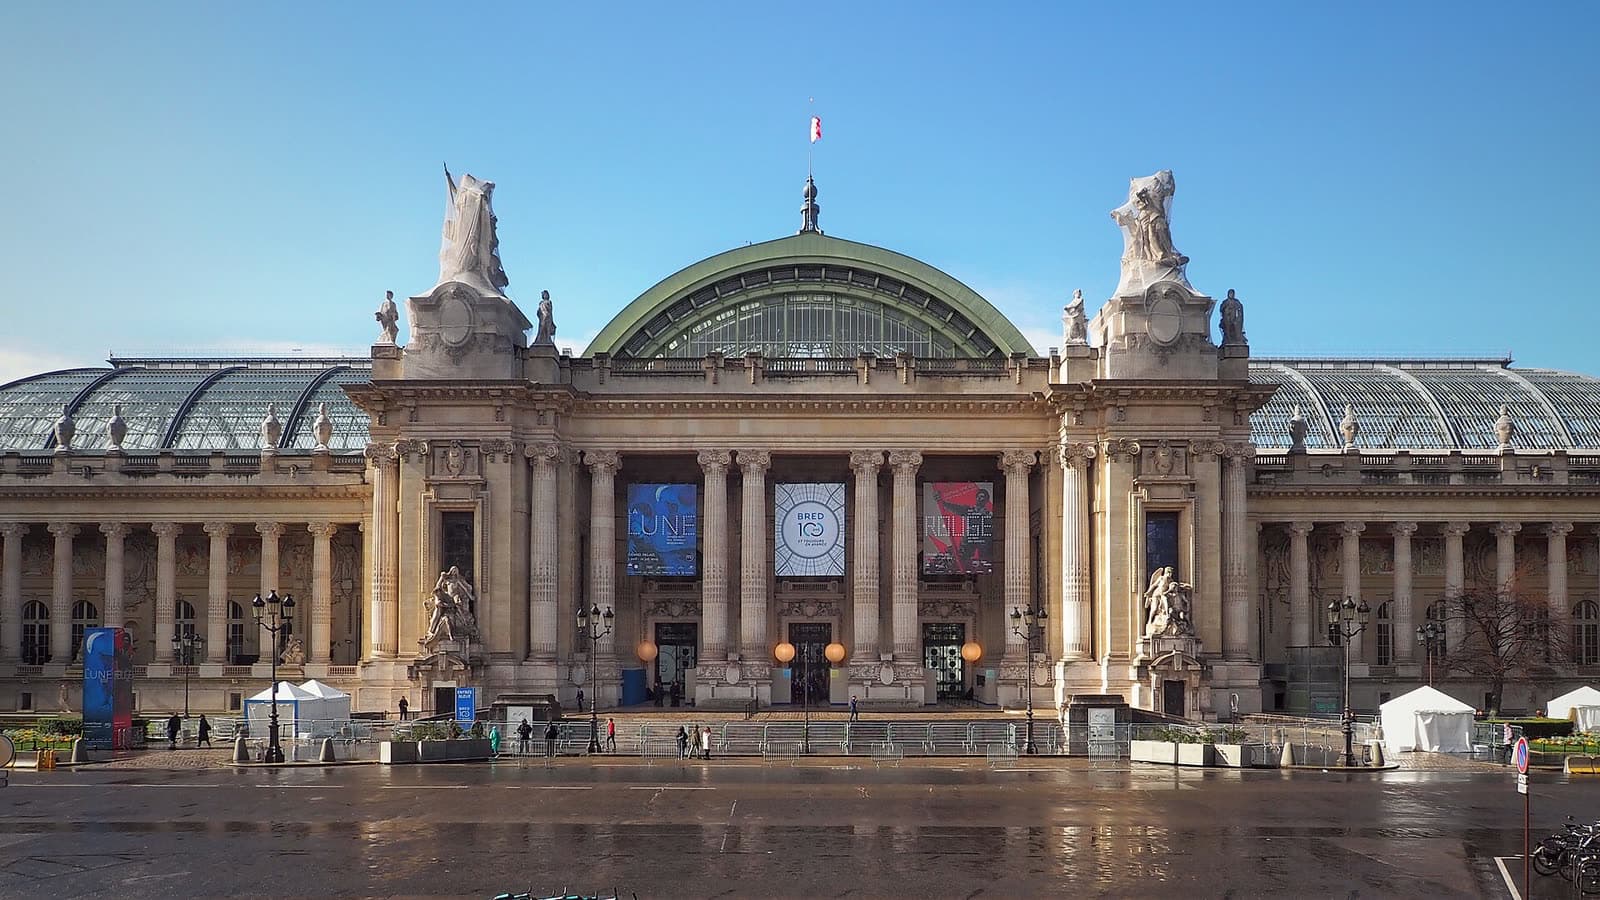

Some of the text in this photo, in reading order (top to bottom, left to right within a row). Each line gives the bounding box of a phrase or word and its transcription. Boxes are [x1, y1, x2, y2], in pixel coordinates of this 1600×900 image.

[627, 515, 696, 536] LUNE
[925, 515, 992, 537] ROUGE
[84, 669, 113, 680] LUNE
